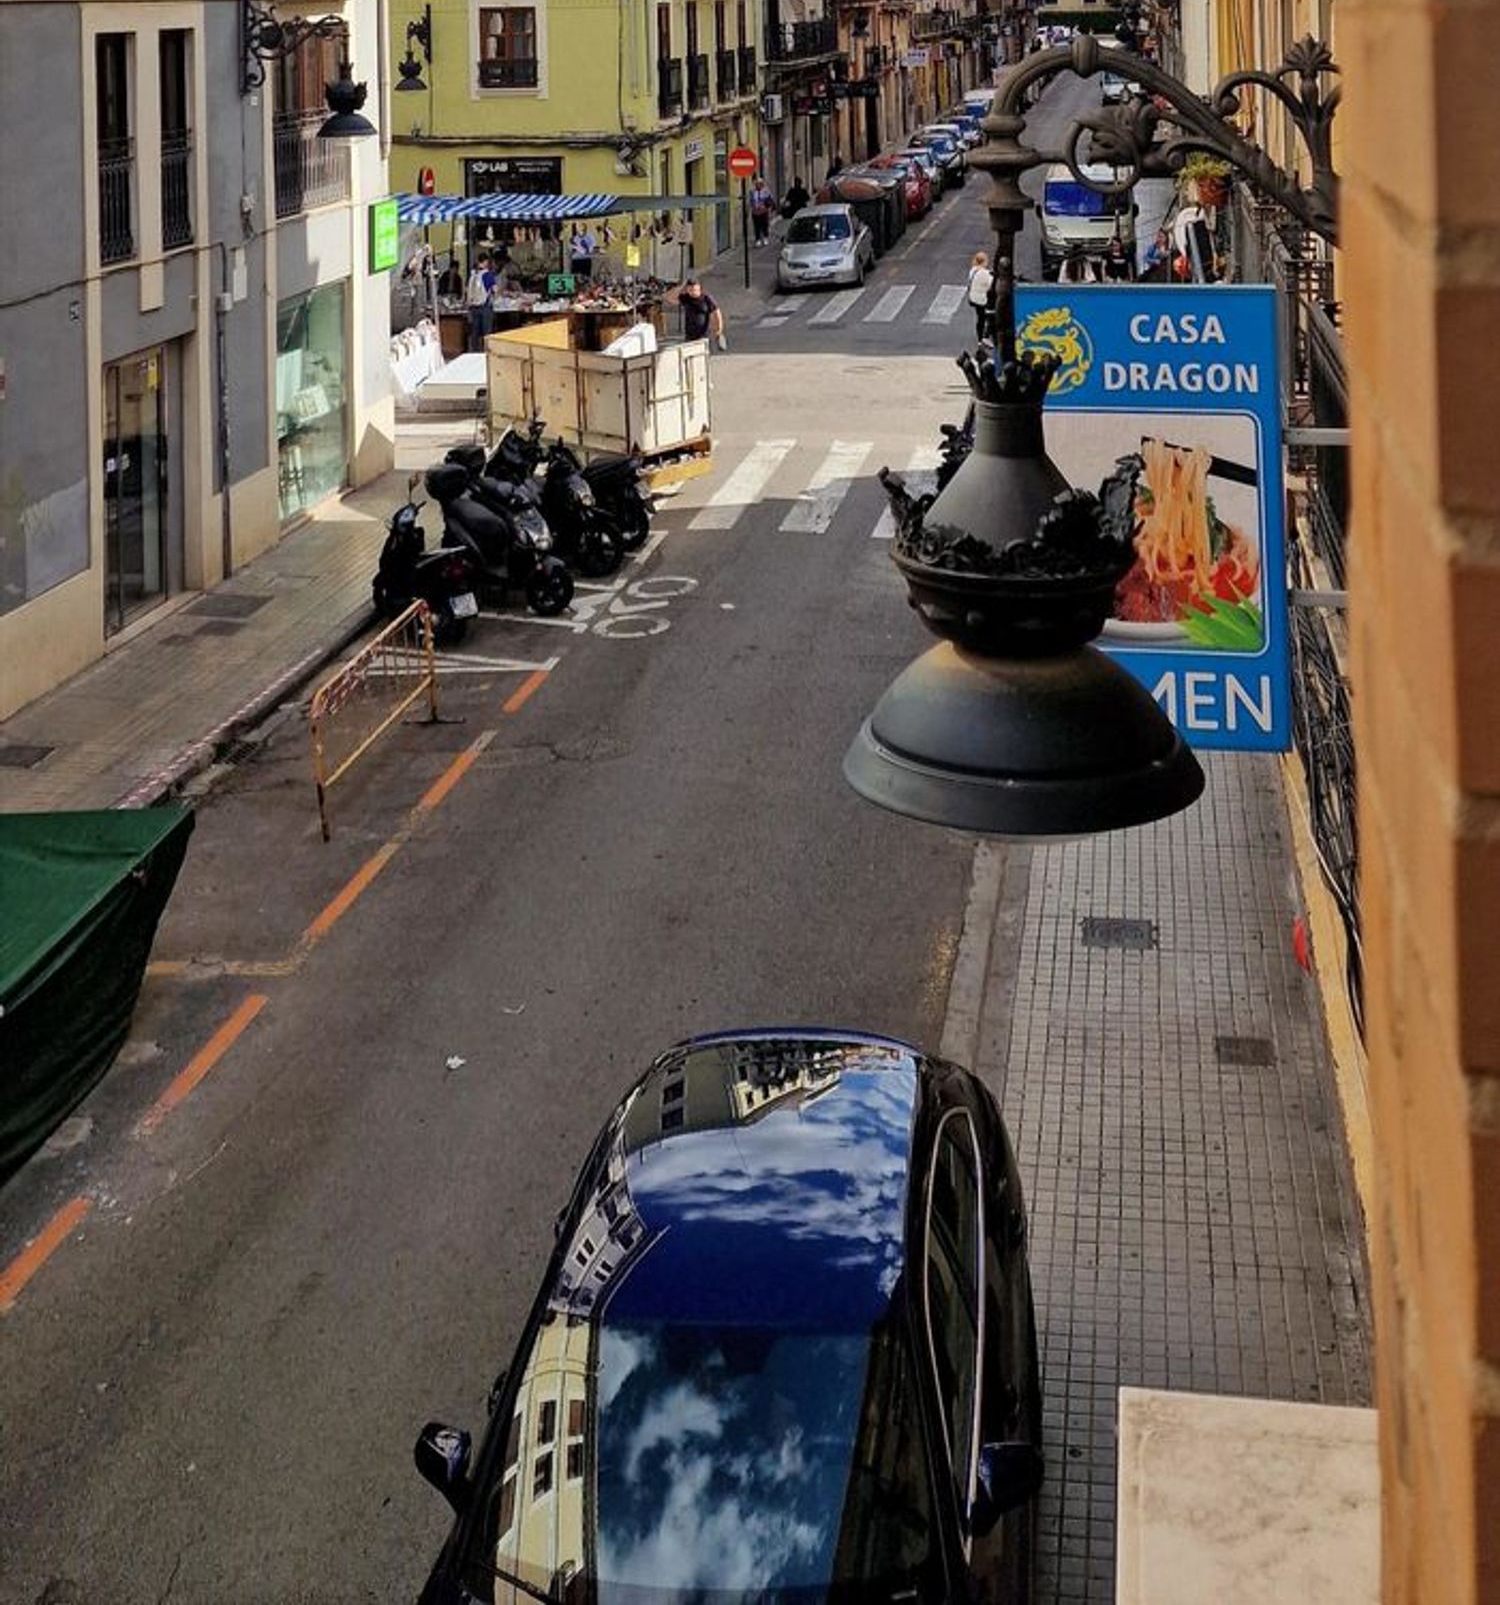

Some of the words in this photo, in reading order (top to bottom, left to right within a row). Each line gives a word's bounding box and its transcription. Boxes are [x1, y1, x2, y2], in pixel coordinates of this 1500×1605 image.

[490, 162, 508, 172] LAB
[1129, 314, 1226, 344] CASA
[1103, 362, 1258, 393] DRAGON
